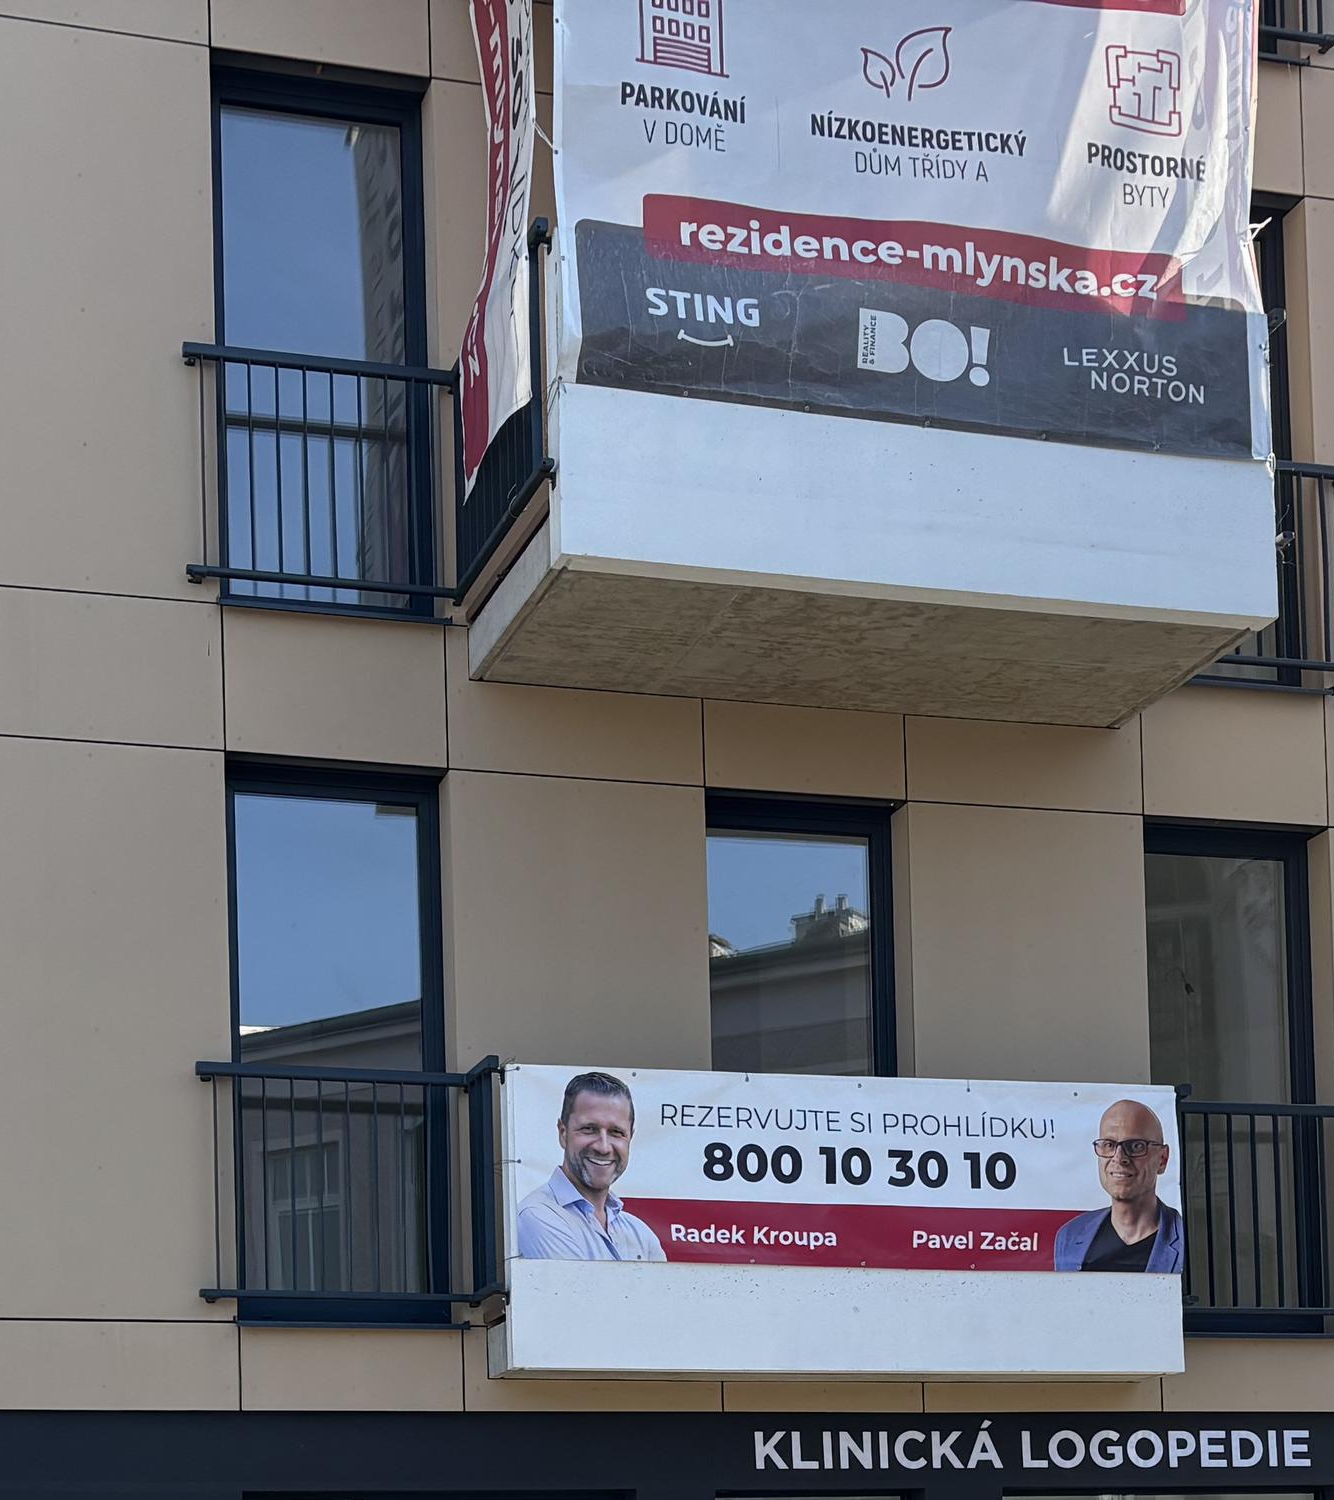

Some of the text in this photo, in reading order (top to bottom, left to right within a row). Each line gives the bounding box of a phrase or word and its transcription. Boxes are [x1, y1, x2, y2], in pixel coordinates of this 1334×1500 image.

[620, 81, 747, 124] PARKOVÁNÍ
[643, 118, 726, 152] V DOMĚ
[810, 110, 1028, 157] NÍZKOENERGETICKÝ
[855, 147, 989, 183] DŮM TŘÍDY A
[1087, 142, 1207, 182] PROSTORNÉ
[1123, 182, 1170, 209] BYTY
[680, 219, 1159, 301] rezidence-mlynska.cz
[645, 287, 761, 327] STING
[861, 324, 871, 364] REALITY
[869, 314, 877, 357] FINANCE
[1063, 346, 1178, 377] LEXXUS
[1089, 369, 1206, 405] NORTON
[660, 1103, 1056, 1139] REZERVUJTE SI PROHLÍDKU!
[702, 1142, 1018, 1191] 800 10 30 10
[670, 1224, 837, 1250] Radek Kroupa
[912, 1230, 1039, 1252] Pavel Začal
[754, 1419, 1312, 1470] KLINICKÁ LOGOPEDIE
